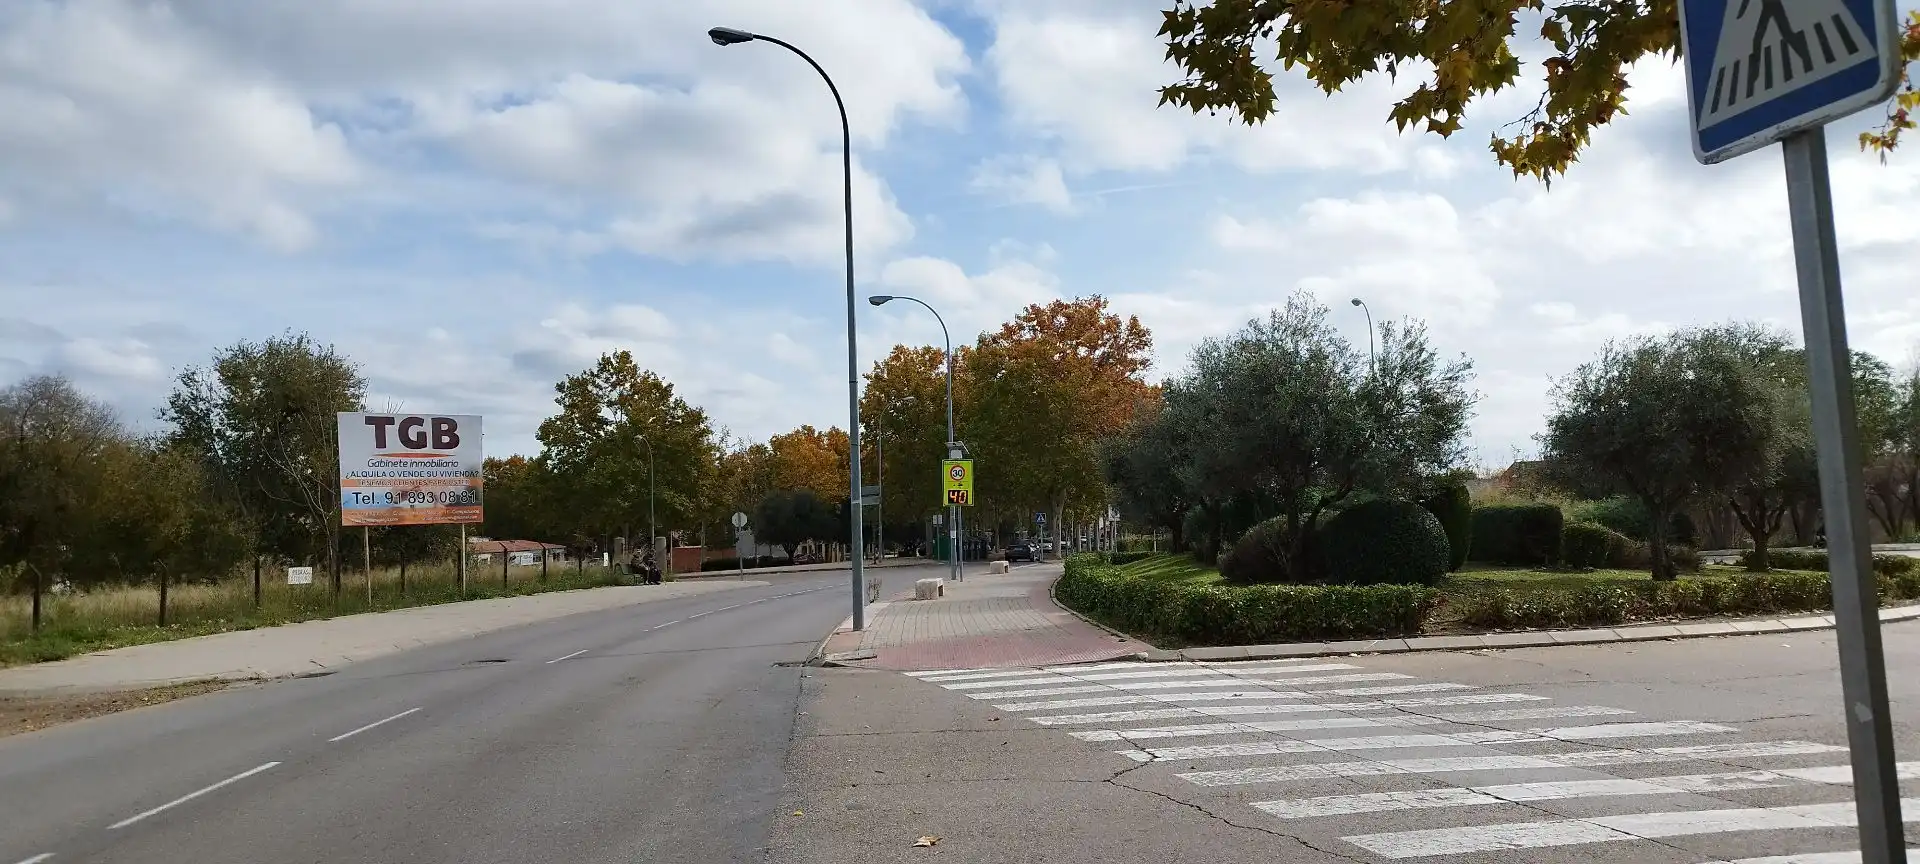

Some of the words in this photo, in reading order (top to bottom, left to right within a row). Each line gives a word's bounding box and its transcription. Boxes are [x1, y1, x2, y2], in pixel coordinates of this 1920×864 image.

[365, 416, 460, 449] TGB
[367, 458, 408, 468] Gabinete
[409, 458, 459, 468] inmobiliario
[345, 470, 387, 479] ¿ALQUILA
[388, 470, 395, 478] O
[397, 470, 424, 478] VENDE
[426, 470, 438, 478] SU
[440, 470, 479, 478] VIVIENDA?
[351, 491, 380, 505] Tel.
[384, 491, 402, 505] 91
[407, 491, 435, 504] 893
[439, 490, 456, 504] 08
[460, 489, 477, 504] 81
[950, 490, 966, 504] 40
